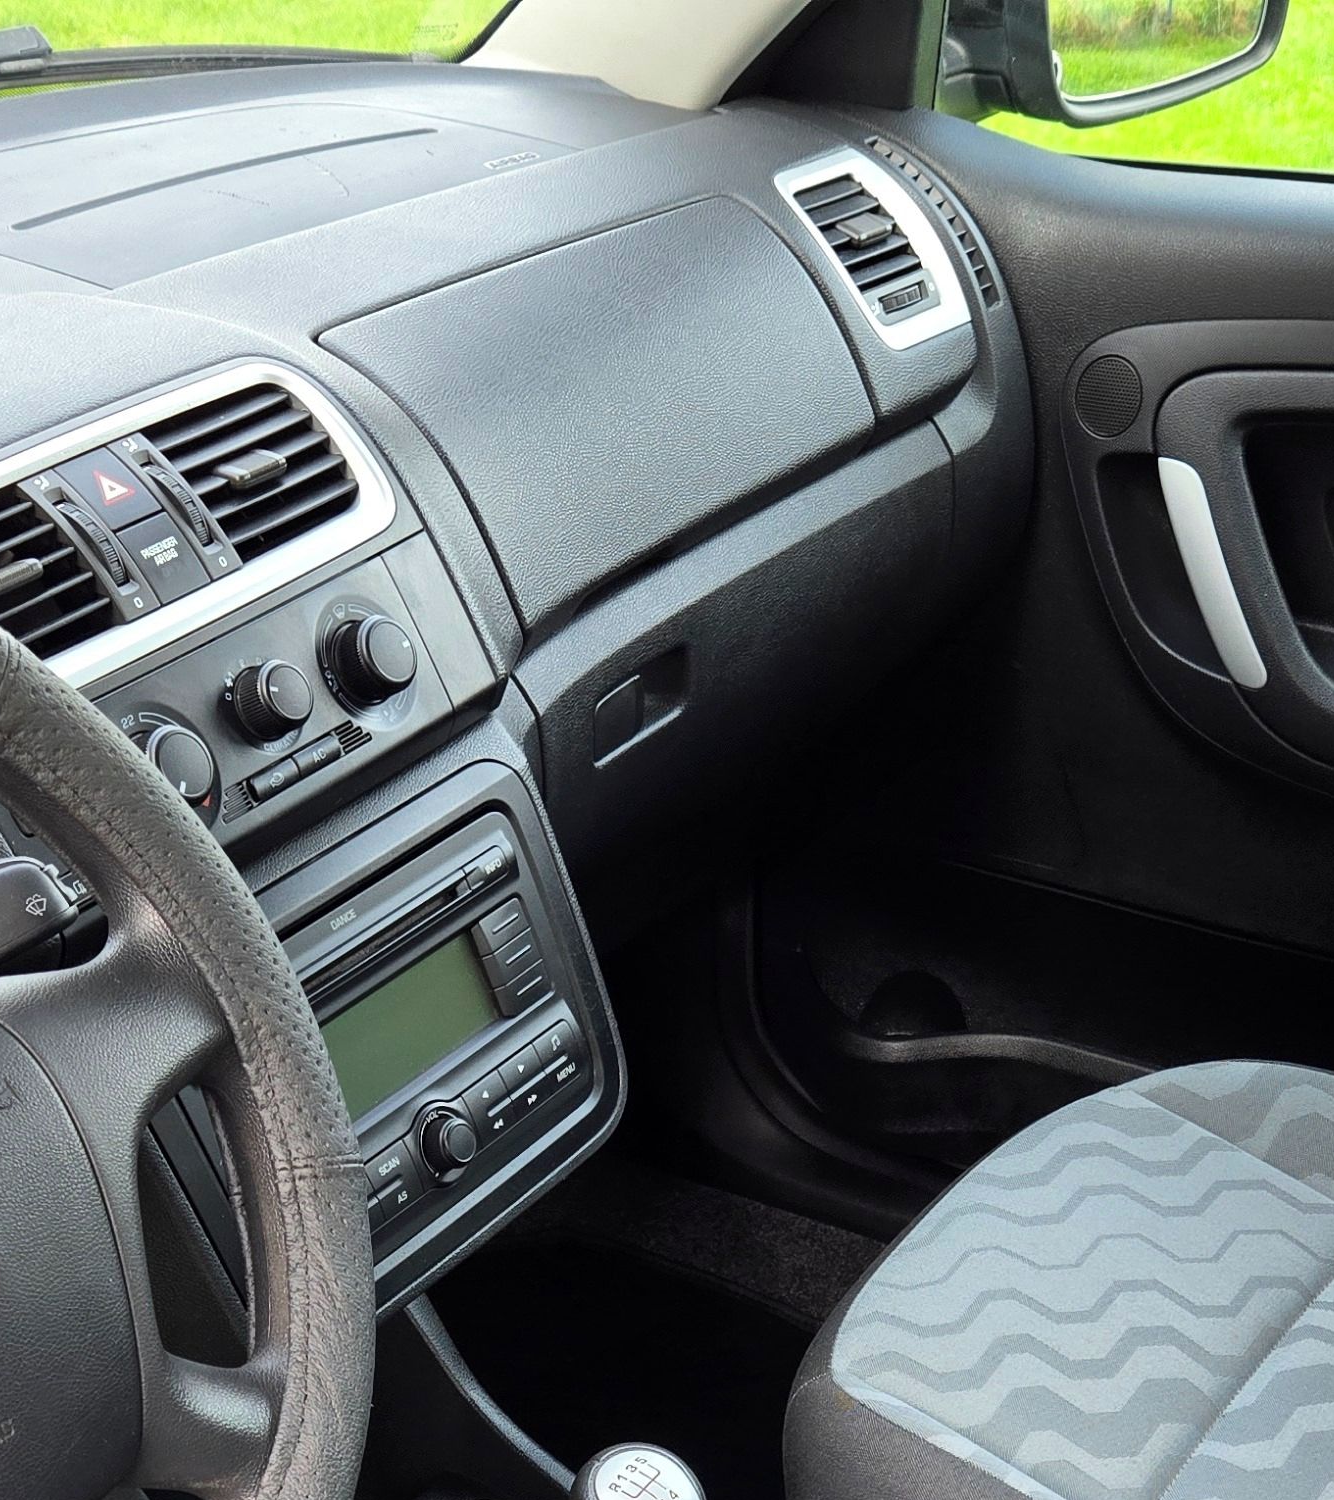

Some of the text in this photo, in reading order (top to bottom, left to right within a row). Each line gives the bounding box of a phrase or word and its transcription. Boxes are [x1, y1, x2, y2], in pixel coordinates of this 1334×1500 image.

[140, 535, 178, 559] PASSENGER
[154, 547, 178, 566] AIRBAG
[121, 714, 135, 729] 22
[313, 748, 327, 763] AC
[484, 858, 502, 875] INFO
[330, 908, 357, 930] DANCE
[556, 1061, 576, 1083] MENU
[426, 1109, 439, 1124] VOL
[378, 1156, 401, 1177] SCAN
[397, 1190, 408, 1205] AS
[625, 1464, 638, 1473] 3
[635, 1456, 648, 1465] 5
[669, 1489, 679, 1500] 4
